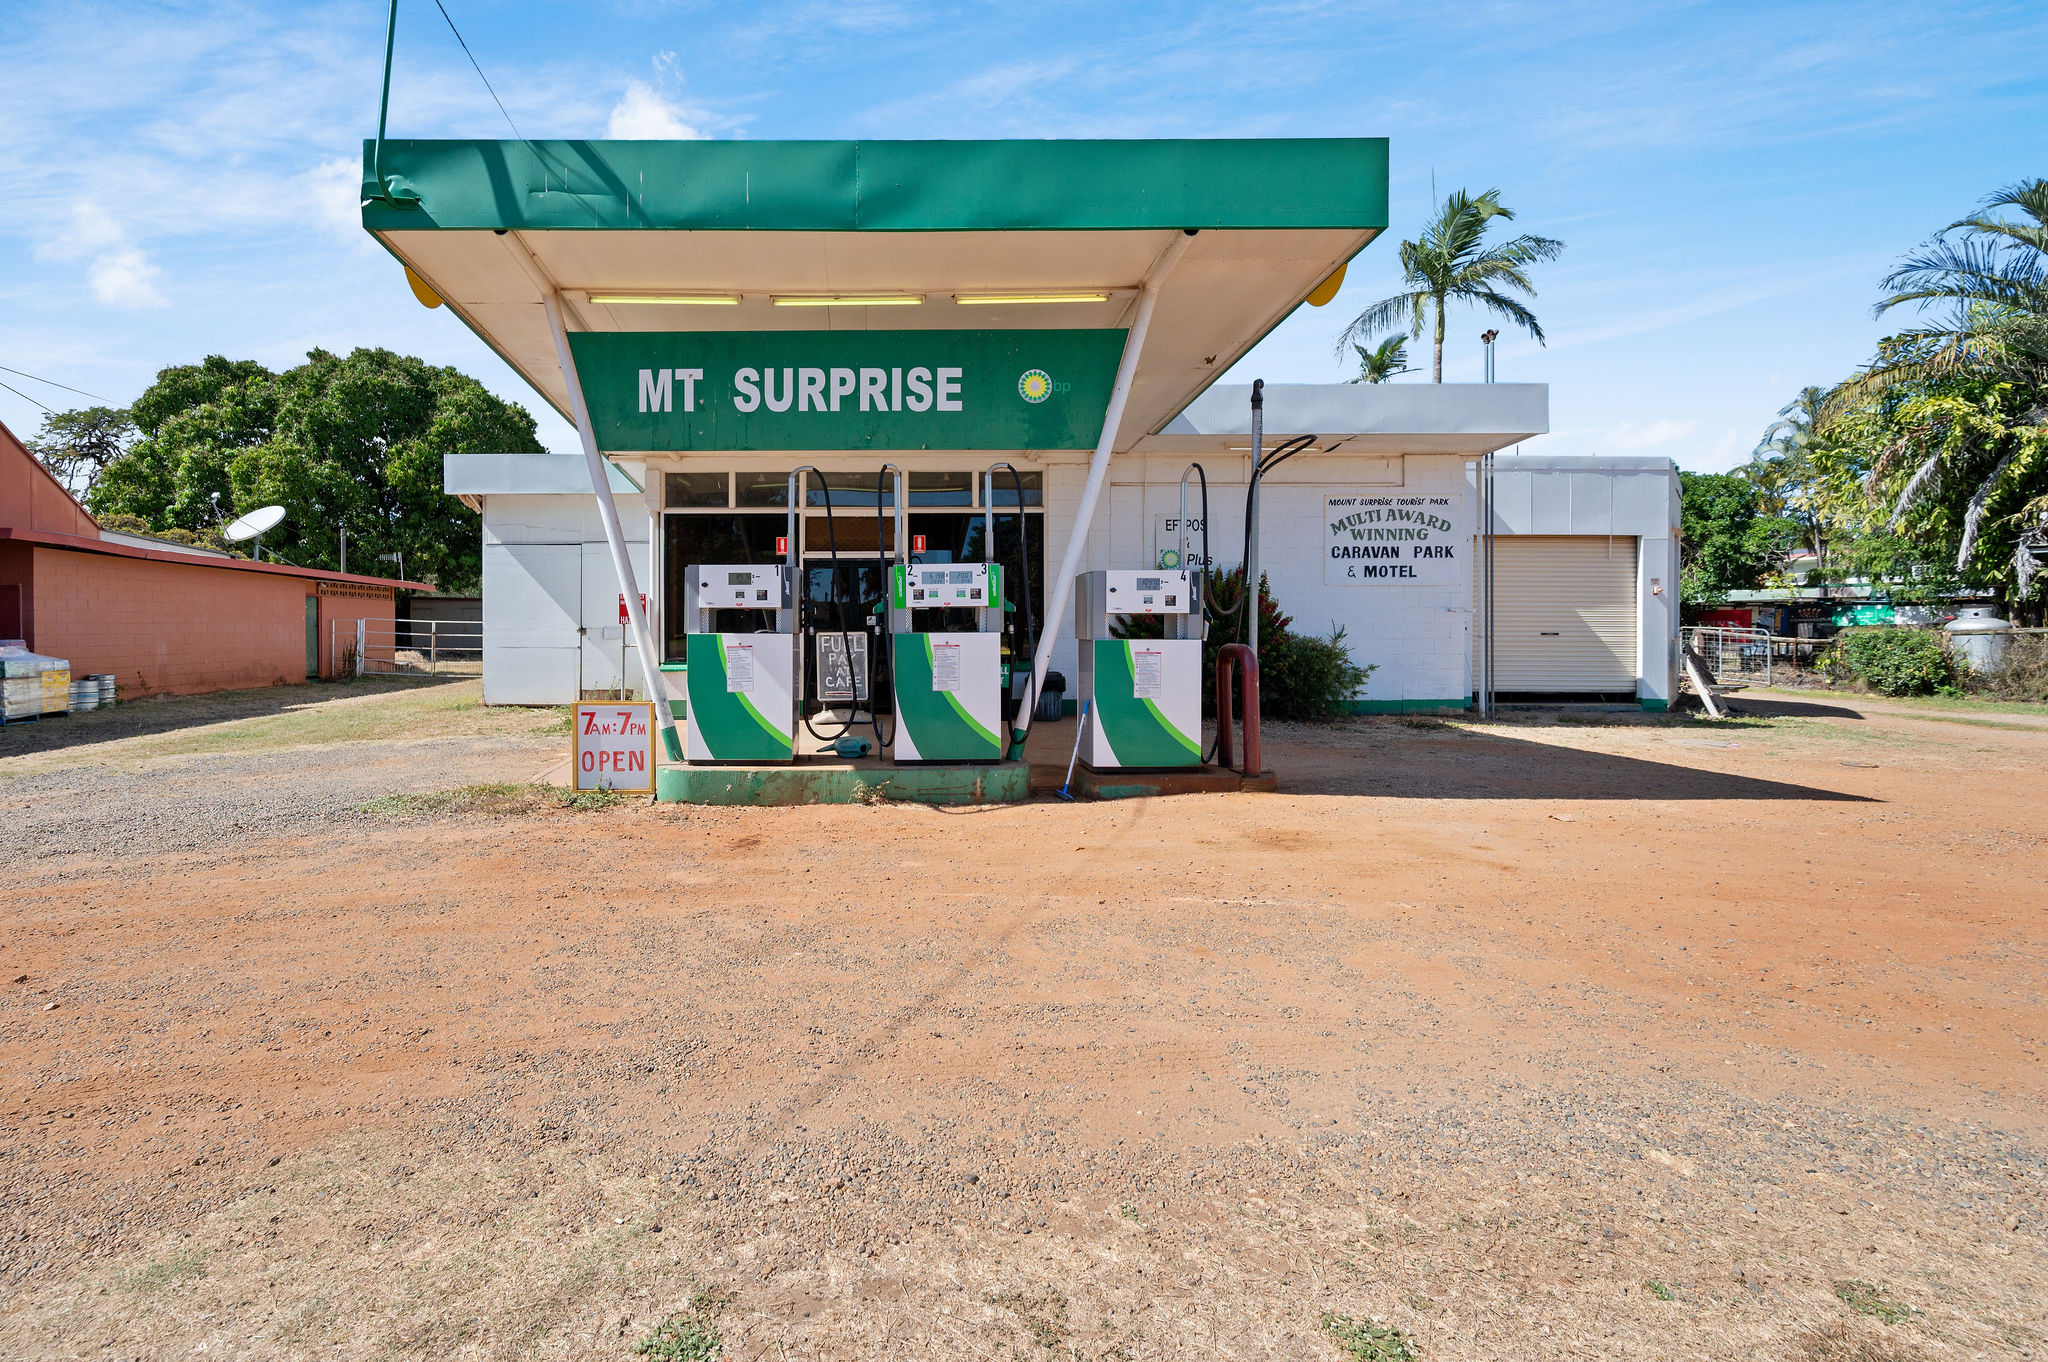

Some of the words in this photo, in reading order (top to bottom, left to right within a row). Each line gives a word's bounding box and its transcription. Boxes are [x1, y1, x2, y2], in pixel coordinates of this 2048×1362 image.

[638, 368, 703, 413] MT
[733, 367, 963, 413] SURPRISE
[1053, 379, 1071, 395] bp
[1328, 498, 1357, 506] MOUNT
[1429, 498, 1449, 506] PARK
[1165, 519, 1207, 531] EFPOS
[1330, 509, 1382, 536] MULTI
[1385, 508, 1452, 532] AWARD
[1350, 528, 1429, 541] WINNING
[1331, 546, 1400, 559] CARAVAN
[1414, 545, 1454, 559] PARK
[1187, 553, 1213, 566] Plus
[774, 564, 779, 576] 1
[907, 564, 913, 576] 2
[981, 563, 987, 575] 3
[1180, 570, 1187, 581] 4
[1364, 565, 1417, 578] MOTEL
[821, 636, 865, 653] FUEL
[836, 666, 850, 678] AT
[825, 676, 863, 688] CAFE
[581, 750, 645, 773] OPEN
